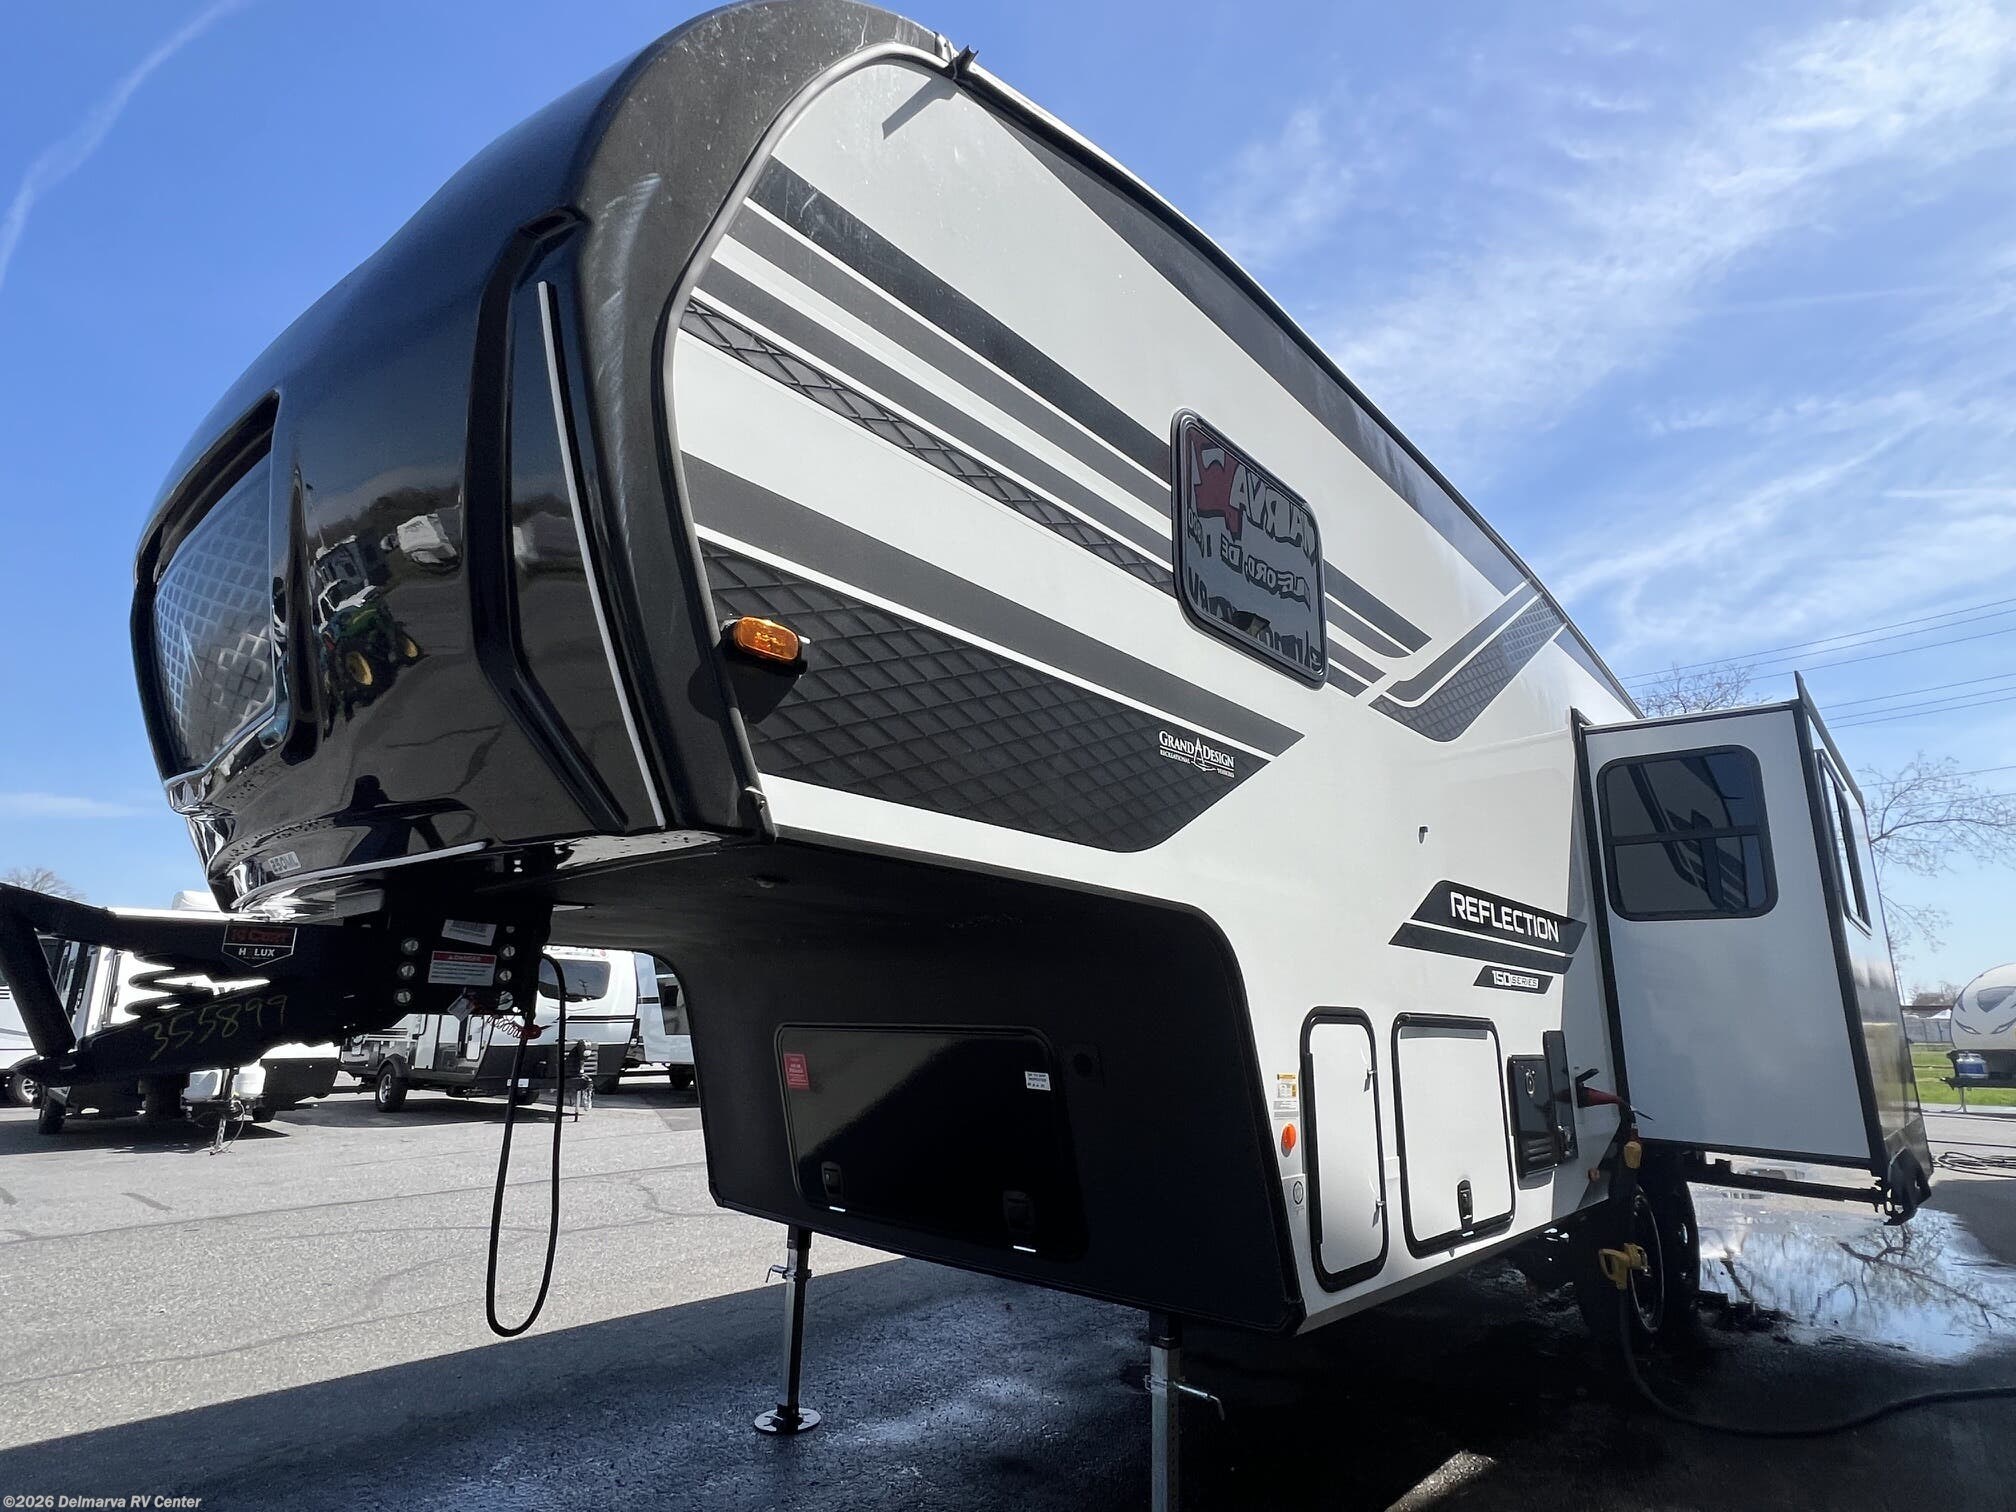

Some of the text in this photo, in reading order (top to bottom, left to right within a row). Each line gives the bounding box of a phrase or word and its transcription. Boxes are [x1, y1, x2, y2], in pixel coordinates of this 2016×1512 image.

[1159, 730, 1235, 768] GRAND DESIGN
[1450, 891, 1559, 943] REFLECTION
[1491, 970, 1538, 989] 150 SERIES
[142, 994, 288, 1061] 355899
